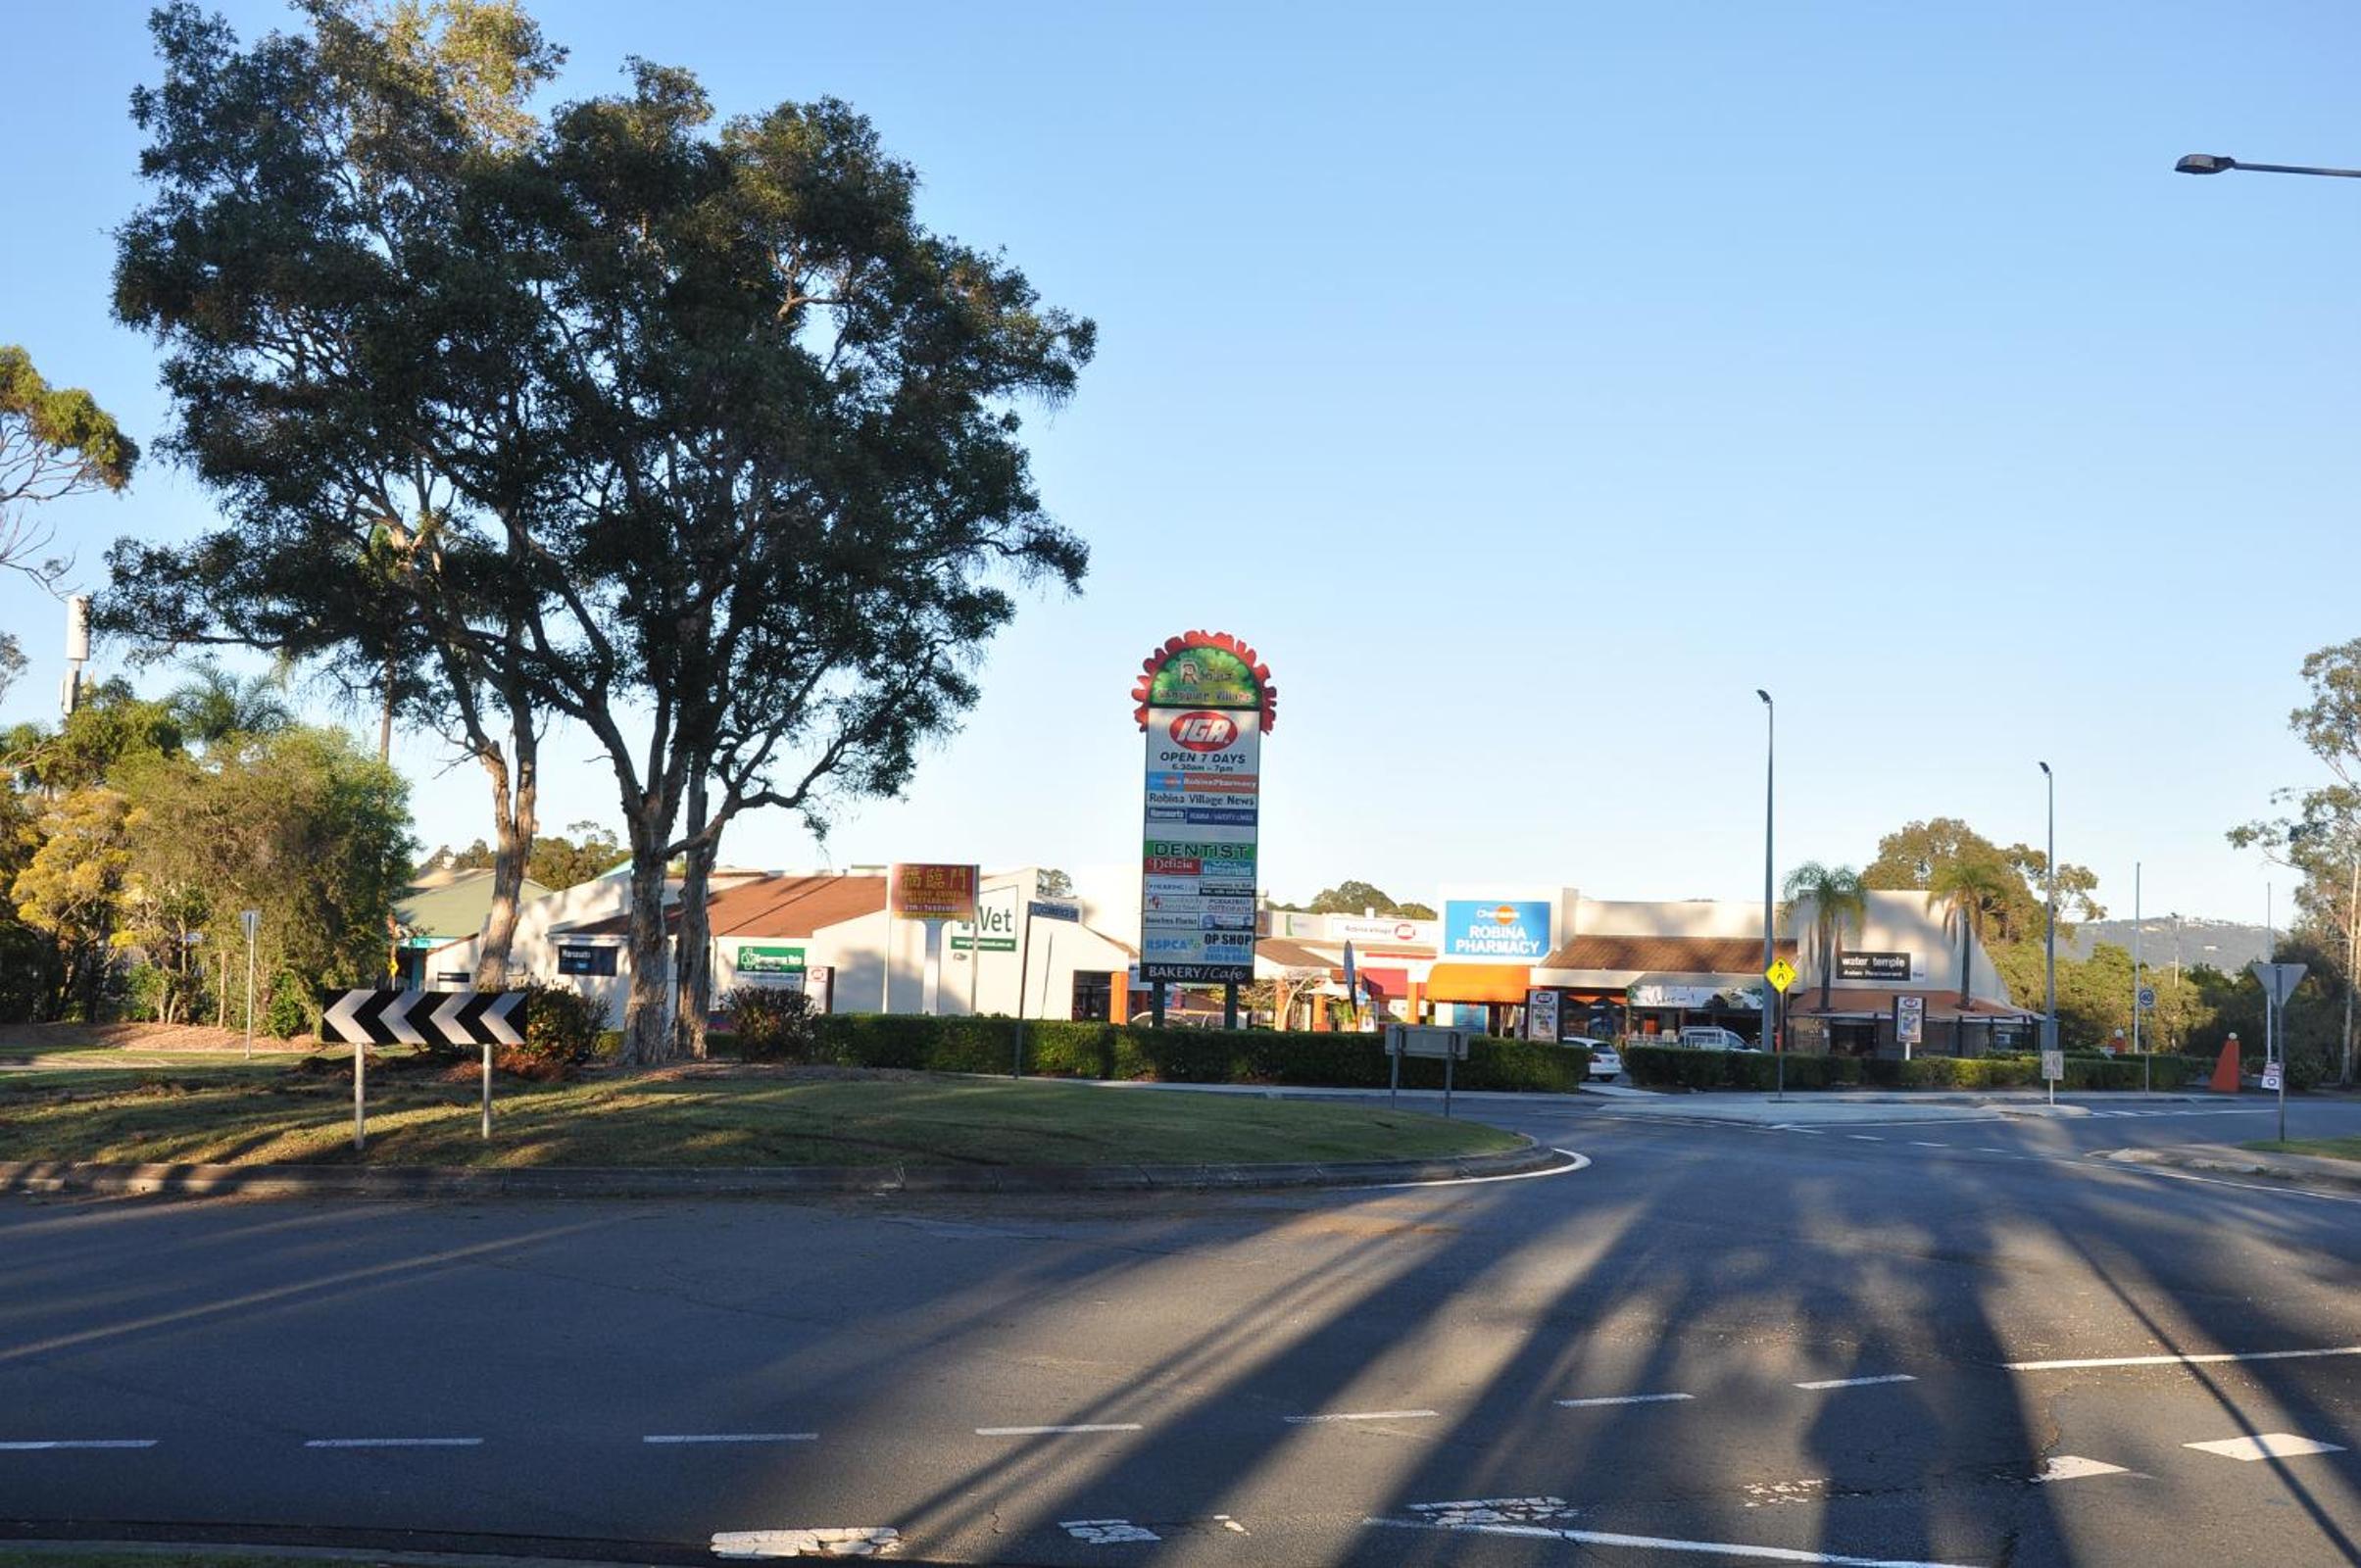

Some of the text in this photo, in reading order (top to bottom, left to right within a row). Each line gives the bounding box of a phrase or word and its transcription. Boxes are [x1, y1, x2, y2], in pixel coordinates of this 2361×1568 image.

[1177, 718, 1229, 743] IGA
[1160, 753, 1246, 763] OPEN 7 DAYS
[1150, 793, 1254, 806] Robina Village News
[1155, 843, 1247, 858] DENTIST
[980, 906, 1012, 932] Vet
[1470, 926, 1526, 939] ROBINA
[1205, 934, 1252, 946] OP SHOP
[1456, 940, 1540, 954] PHARMACY
[1842, 956, 1905, 969] water temple
